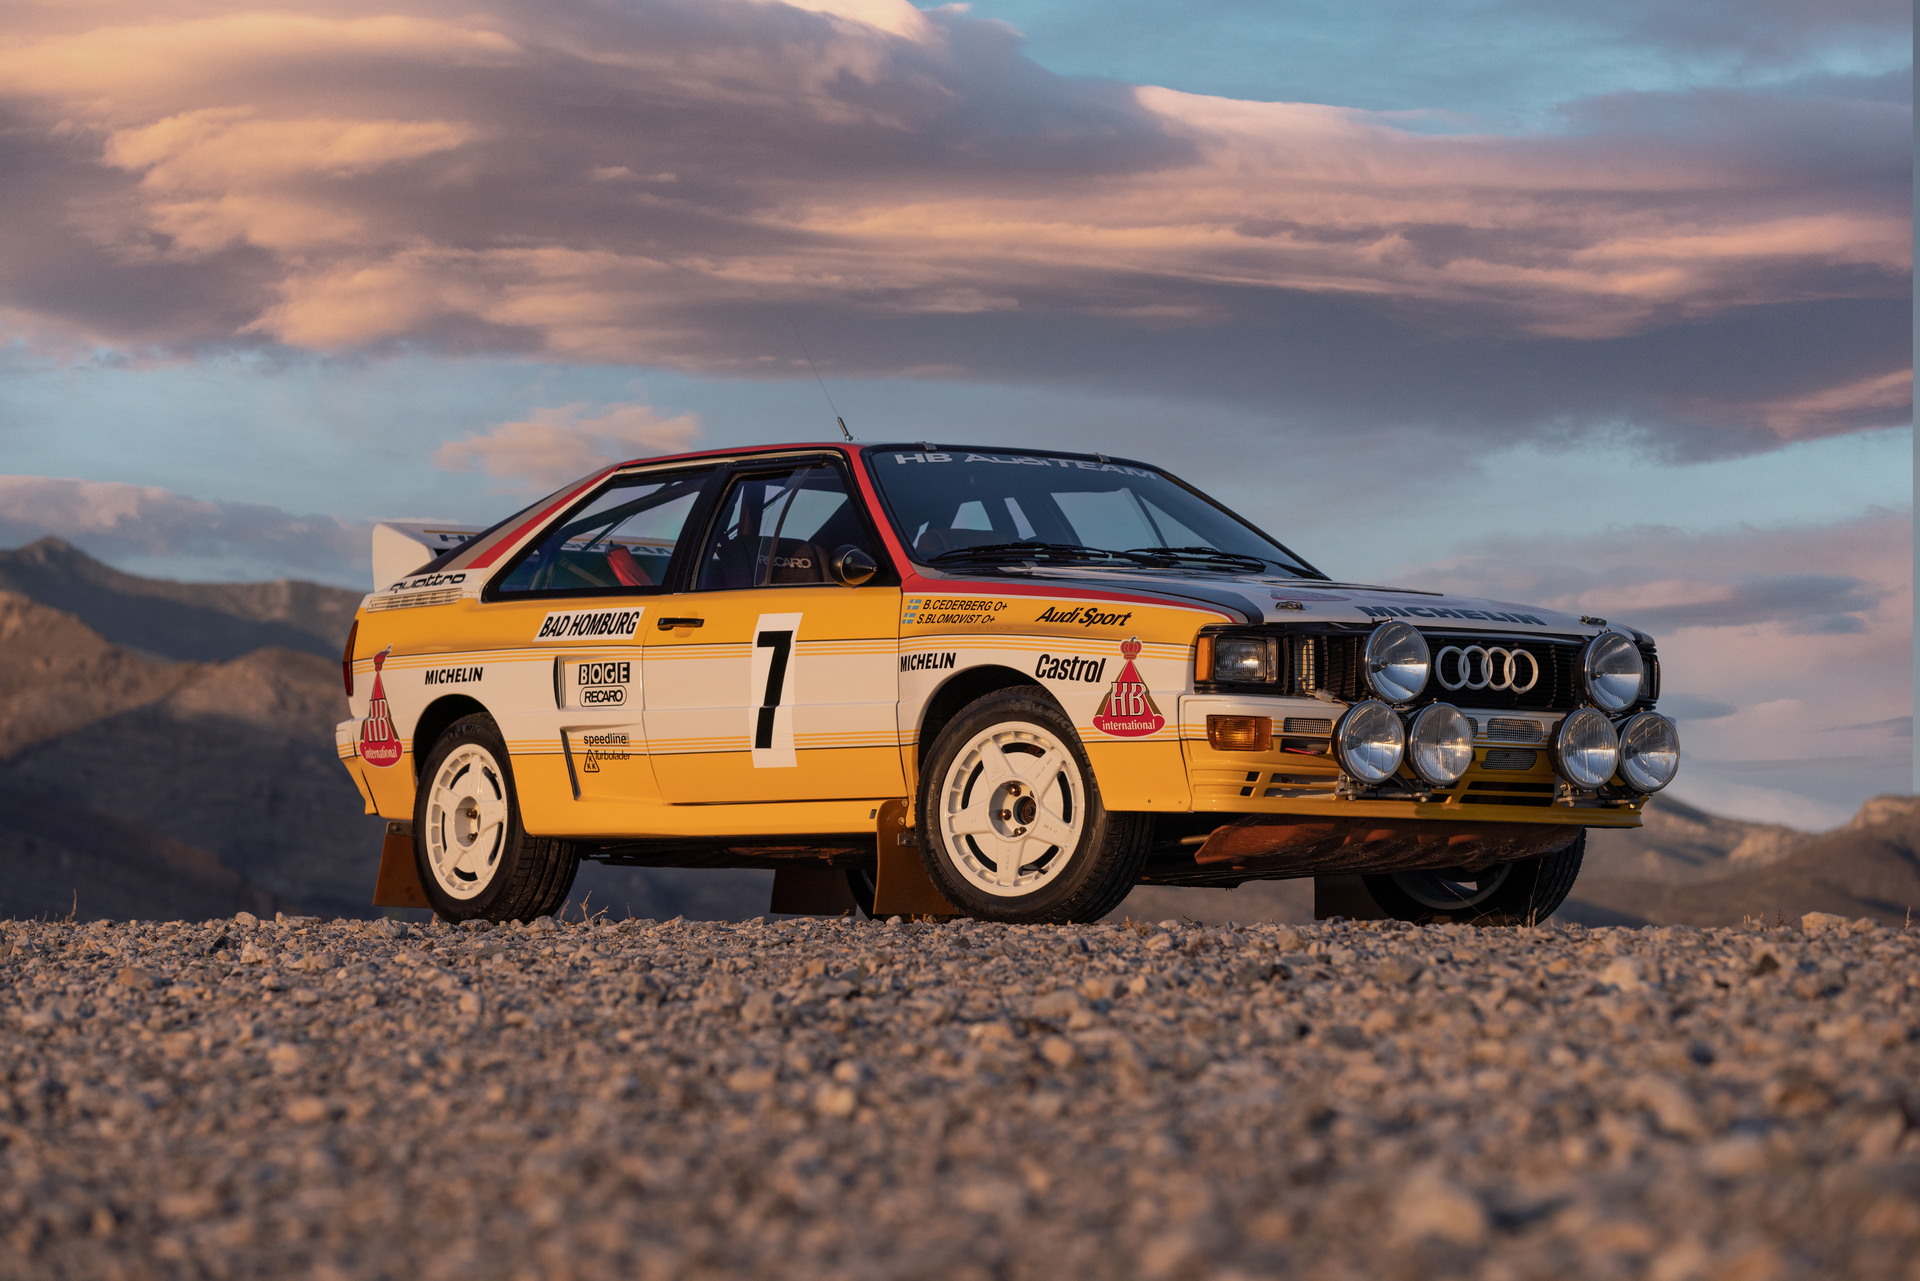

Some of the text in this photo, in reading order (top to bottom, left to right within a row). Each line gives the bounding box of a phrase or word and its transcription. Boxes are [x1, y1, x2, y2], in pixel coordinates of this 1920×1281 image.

[894, 453, 952, 464] HB
[758, 554, 812, 569] RCARO
[389, 573, 467, 593] quattro
[922, 599, 993, 611] B.CEDERBERG
[538, 611, 640, 638] BAD HOMBURG
[916, 613, 981, 624] S.BLOMQVIST
[1034, 606, 1133, 627] Audi Sport
[1354, 605, 1547, 626] MICHELIN
[900, 652, 957, 673] MICHELIN
[1035, 653, 1107, 683] Castrol
[424, 666, 484, 685] MICHELIN
[579, 662, 630, 685] BOGE
[584, 689, 624, 703] RECARO
[755, 630, 794, 749] 7
[1110, 681, 1147, 717] HB
[368, 698, 389, 742] HB
[1102, 719, 1156, 731] international
[583, 733, 627, 747] speedline
[364, 745, 398, 759] international
[594, 750, 631, 760] Turbolader
